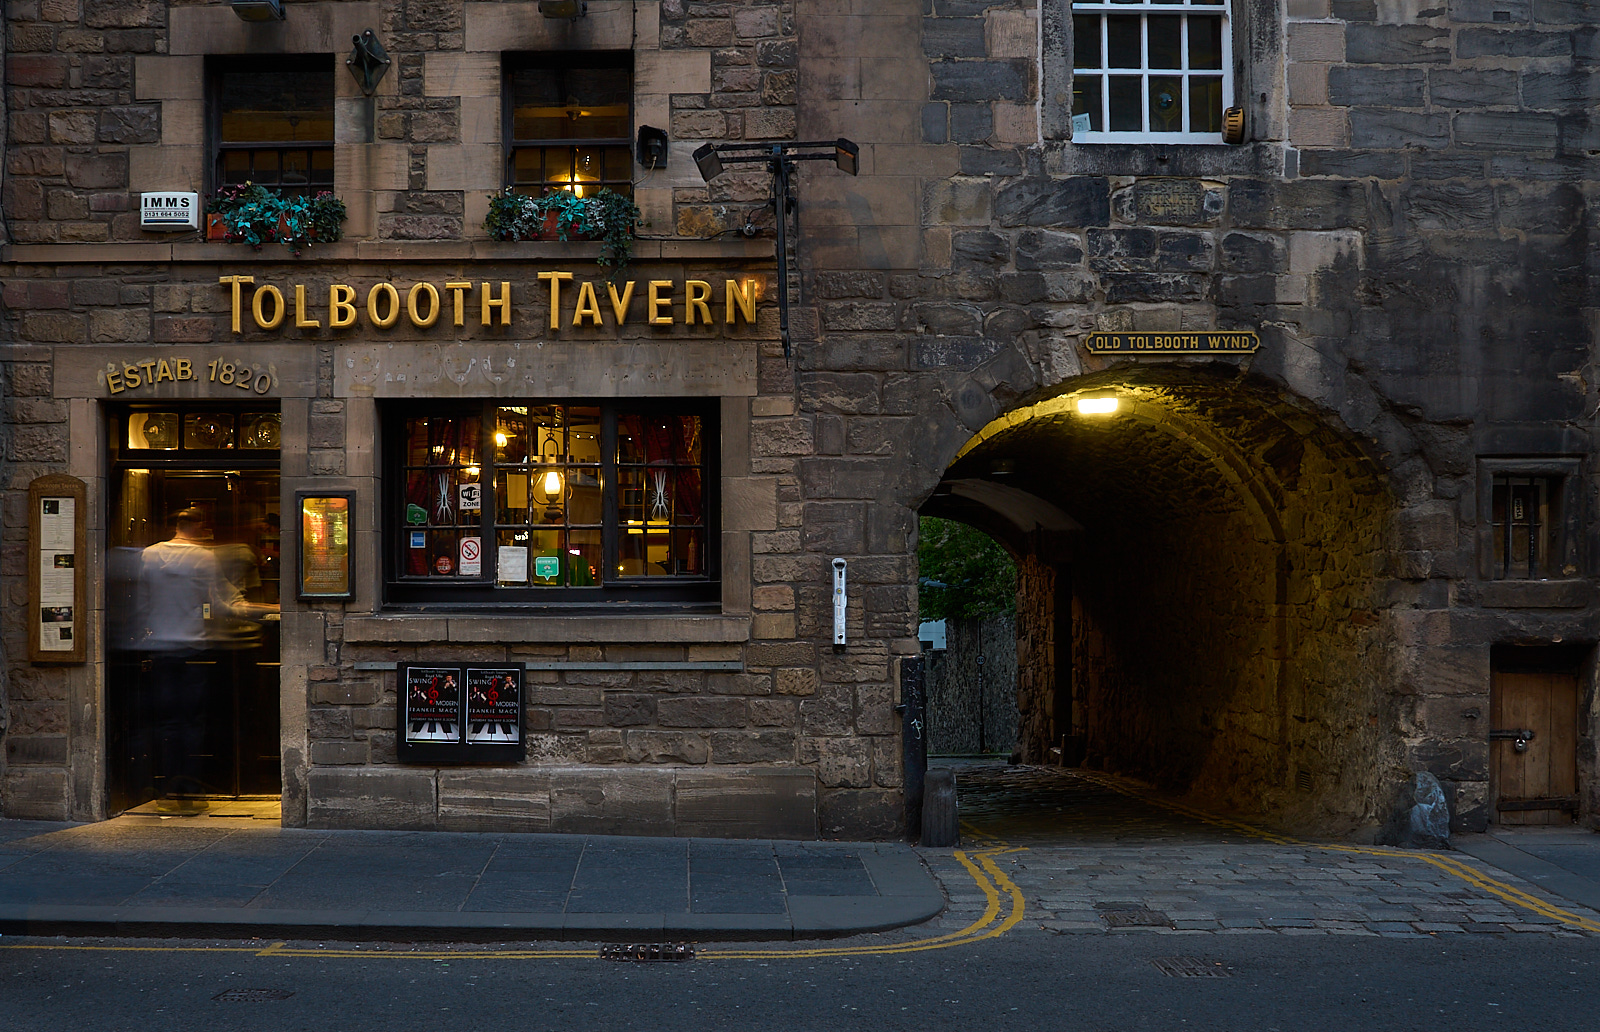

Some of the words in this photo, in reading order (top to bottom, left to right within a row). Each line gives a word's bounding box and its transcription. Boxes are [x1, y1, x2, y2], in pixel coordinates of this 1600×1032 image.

[144, 197, 189, 207] IMMS
[219, 274, 512, 334] TOLBOOTH
[537, 270, 757, 330] TAVERN
[1095, 336, 1121, 349] OLD
[1127, 336, 1199, 349] TOLBOOTH
[1207, 336, 1250, 349] WYND
[106, 358, 199, 395] ESTAB.
[208, 360, 271, 394] 1820
[409, 677, 433, 685] SWING
